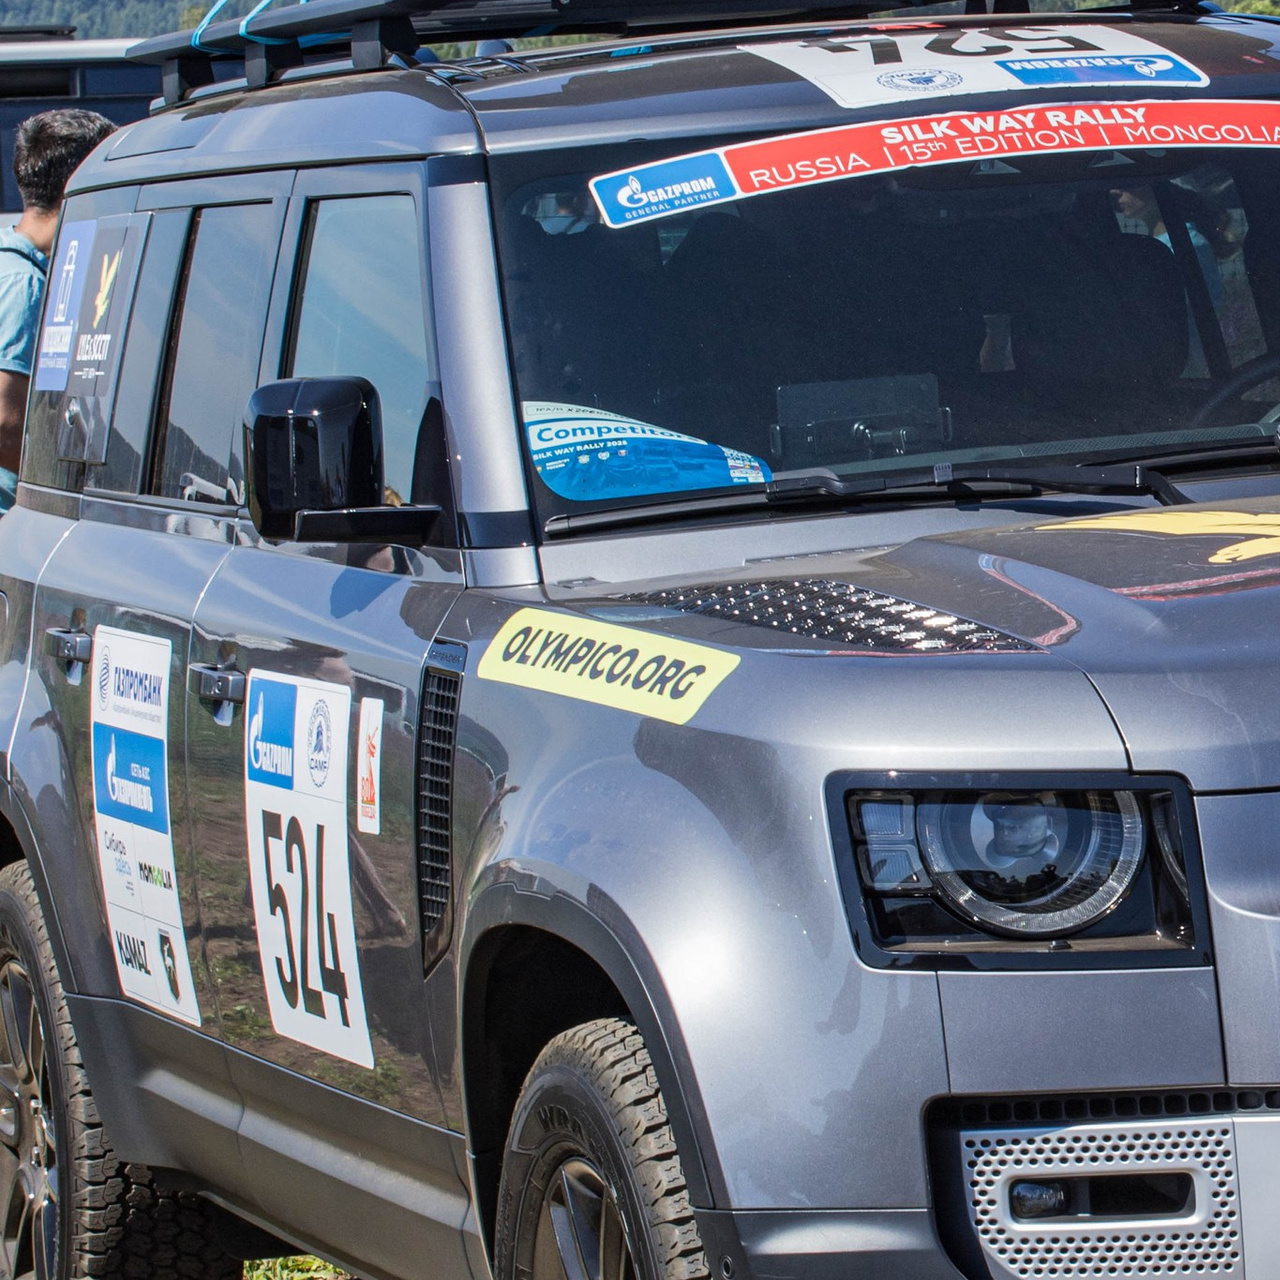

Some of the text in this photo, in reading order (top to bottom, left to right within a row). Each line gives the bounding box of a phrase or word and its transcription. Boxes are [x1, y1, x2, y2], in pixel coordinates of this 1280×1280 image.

[881, 107, 1146, 144] SILK WAY RALLY
[749, 152, 871, 188] RUSSIA
[900, 140, 947, 162] 15th
[955, 128, 1084, 155] EDITION
[625, 191, 720, 219] GENERAL PARTNER
[646, 176, 716, 204] GAZPROM
[532, 451, 553, 461] SILK
[554, 446, 575, 456] WAY
[577, 442, 605, 452] RALLY
[502, 625, 707, 700] OLYMPICO.ORG
[262, 809, 350, 1028] 524
[116, 930, 152, 977] KAMAZ
